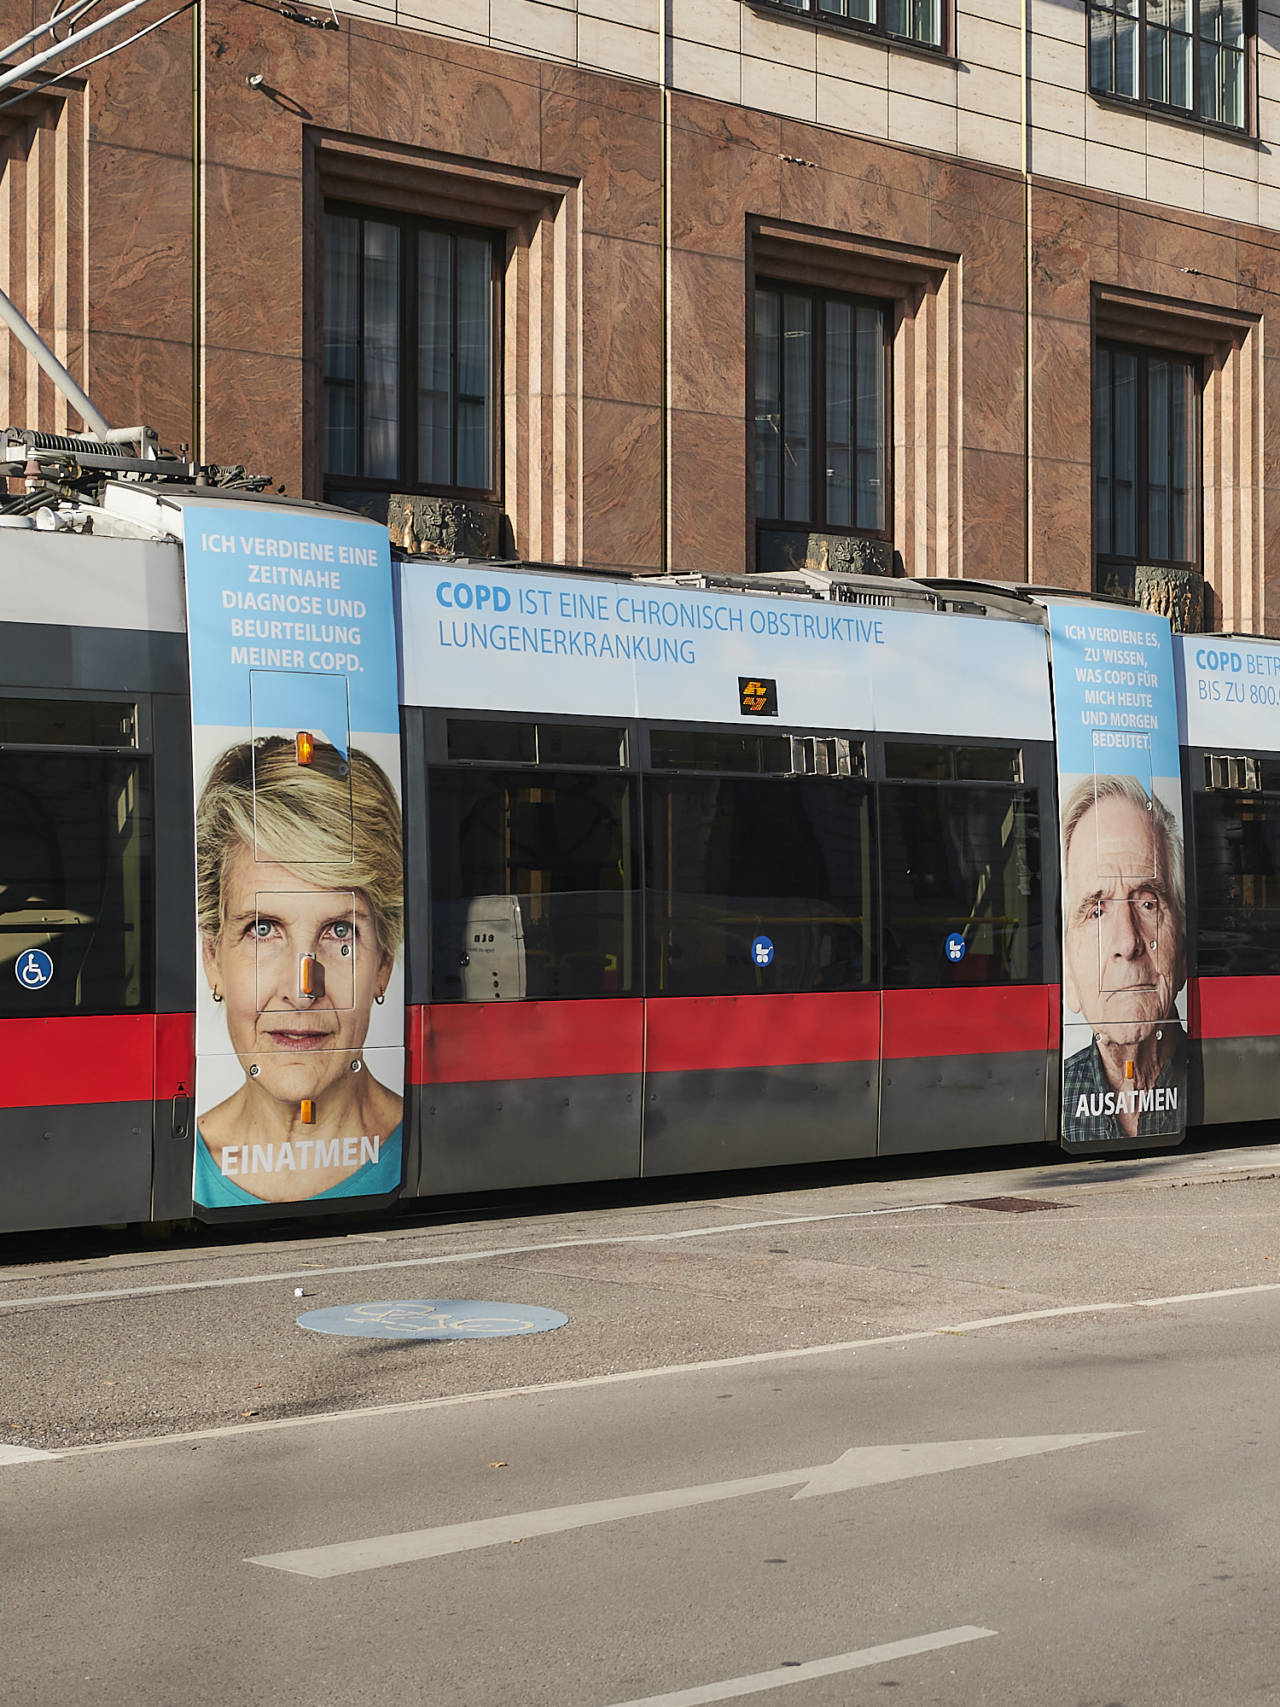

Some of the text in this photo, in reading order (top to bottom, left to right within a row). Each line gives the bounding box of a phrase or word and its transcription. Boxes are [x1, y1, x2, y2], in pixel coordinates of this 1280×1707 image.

[201, 533, 379, 567] ICH VERDIENE EINE
[248, 564, 341, 590] ZEITNAHE
[222, 590, 366, 619] DIAGNOSE UND
[435, 581, 885, 645] COPD IST EINE CHRONISCH OBSTRUKTIVE
[231, 618, 361, 645] BEURTEILUNG
[439, 620, 695, 665] LUNGENERKRANKUNG
[1065, 625, 1161, 649] ICH VERDIENE ES,
[231, 646, 364, 672] MEINER COPD.
[1084, 647, 1148, 668] ZU WISSEN,
[1196, 649, 1242, 673] COPD
[1075, 668, 1158, 688] WAS COPD FÜR
[1198, 679, 1220, 701] BIS
[1225, 682, 1245, 703] ZU
[1085, 690, 1153, 708] MICH HEUTE
[1081, 711, 1158, 730] UND MORGEN
[1075, 1087, 1178, 1118] AUSATMEN
[221, 1135, 380, 1176] EINATMEN
